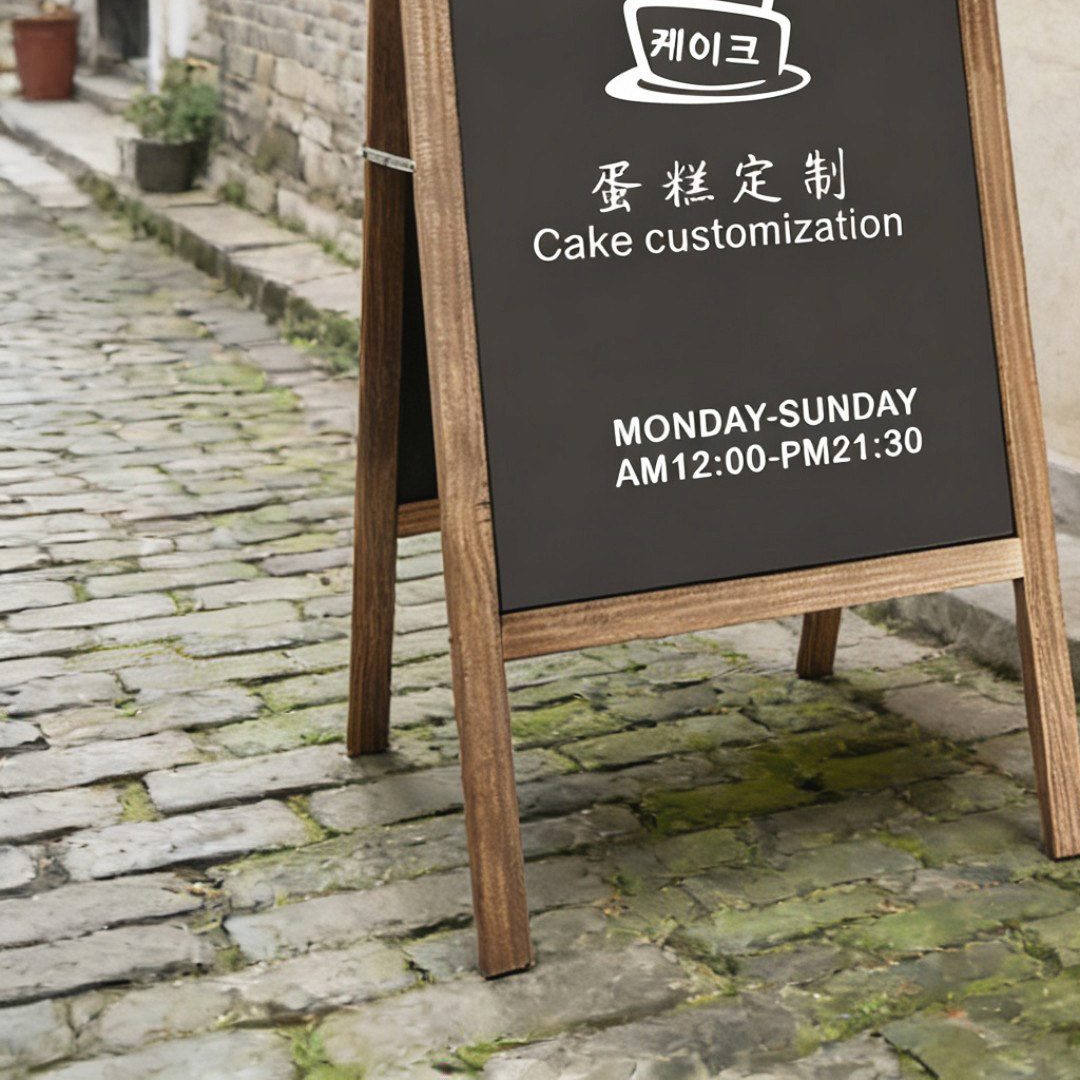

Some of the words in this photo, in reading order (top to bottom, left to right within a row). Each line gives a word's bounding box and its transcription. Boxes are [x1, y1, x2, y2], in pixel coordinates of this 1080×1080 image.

[650, 27, 760, 68] 케이크
[591, 147, 847, 214] 蛋糕定制
[532, 225, 633, 262] Cake
[645, 209, 904, 254] customization
[612, 386, 918, 447] MONDAY-SUNDAY
[615, 426, 923, 488] AM12:00-PM21:30
